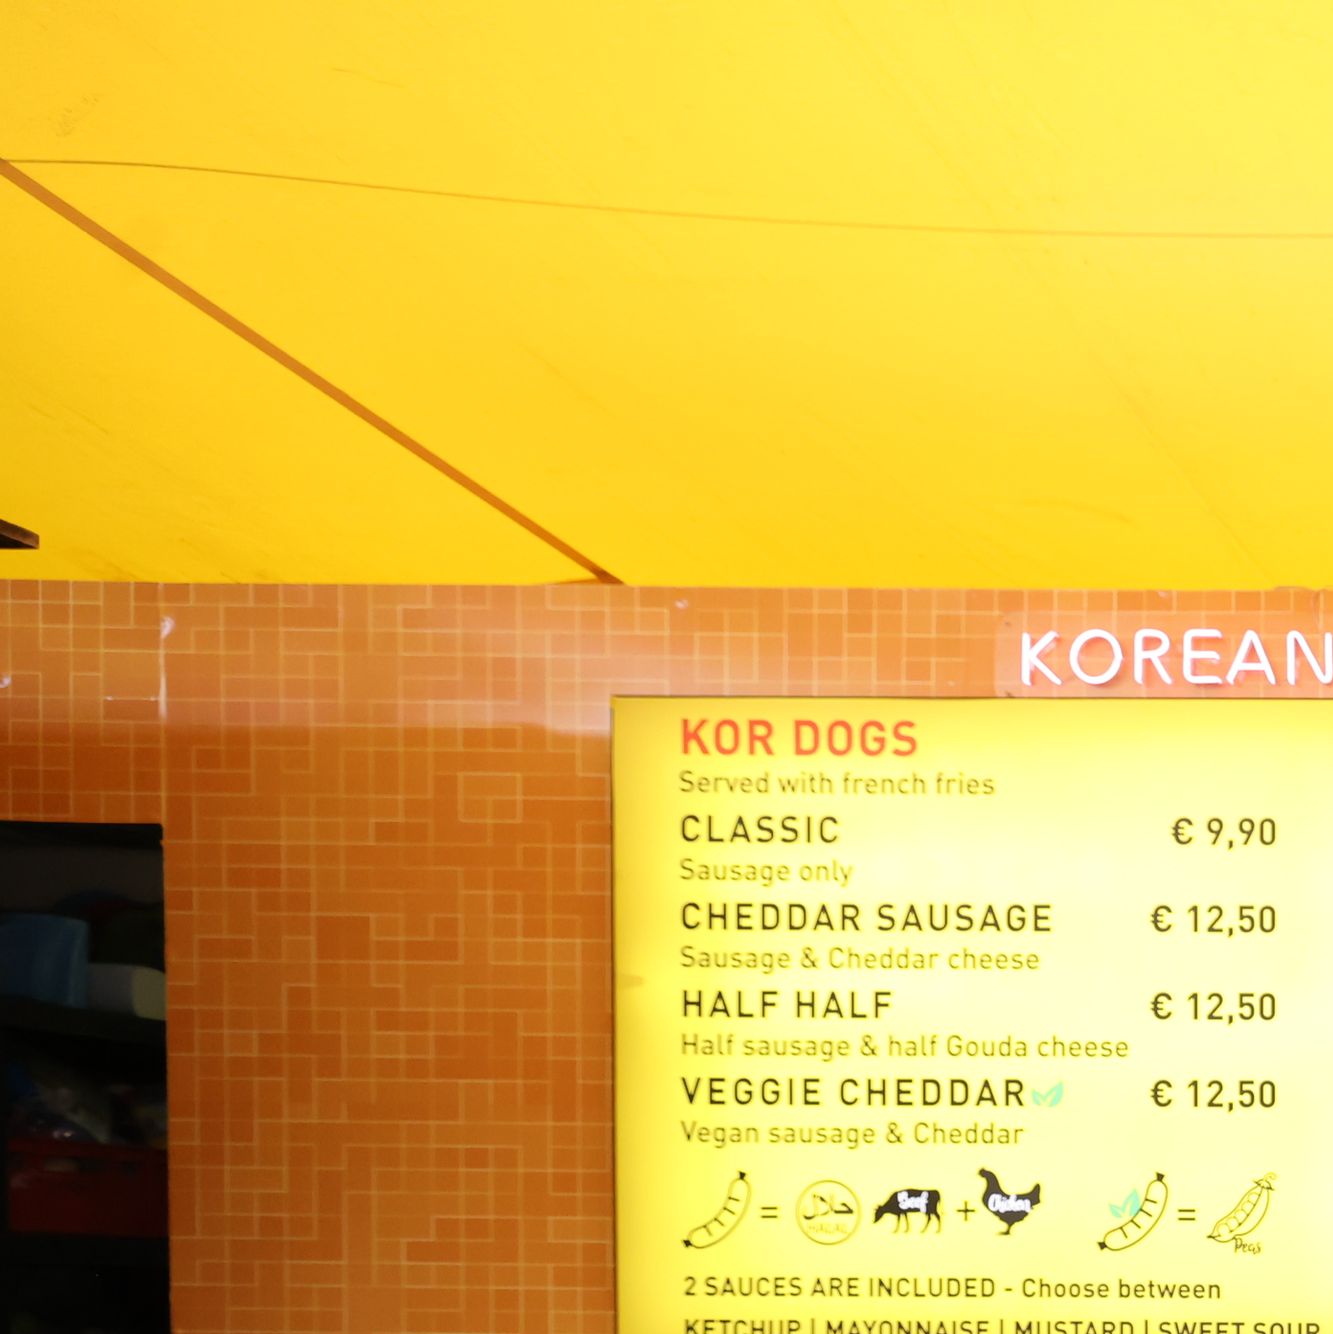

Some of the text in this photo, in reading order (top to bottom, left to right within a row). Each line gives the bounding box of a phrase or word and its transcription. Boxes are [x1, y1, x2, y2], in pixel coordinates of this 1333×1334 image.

[682, 719, 917, 757] KOR DOGS
[679, 770, 994, 794] Served with french fries
[682, 815, 837, 843] CLASSIC
[1172, 818, 1275, 849] € 9,90
[680, 858, 853, 887] Sausage only
[682, 902, 1050, 931] CHEDDAR SAUSAGE
[1151, 905, 1275, 936] € 12,50
[680, 945, 1039, 974] Sausage & Cheddar cheese
[684, 990, 890, 1018] HALF HALF
[1152, 993, 1275, 1024] € 12,50
[682, 1034, 1128, 1062] Half sausage & half Gouda cheese
[682, 1077, 1023, 1106] VEGGIE CHEDDAR
[1151, 1080, 1275, 1111] € 12,50
[680, 1121, 1023, 1149] Vegan sausage & Cheddar
[685, 1276, 696, 1296] 2
[705, 1277, 801, 1296] SAUCES
[812, 1278, 859, 1296] ARE
[870, 1278, 994, 1297] INCLUDED
[1023, 1278, 1109, 1298] Choose
[1119, 1279, 1220, 1298] between
